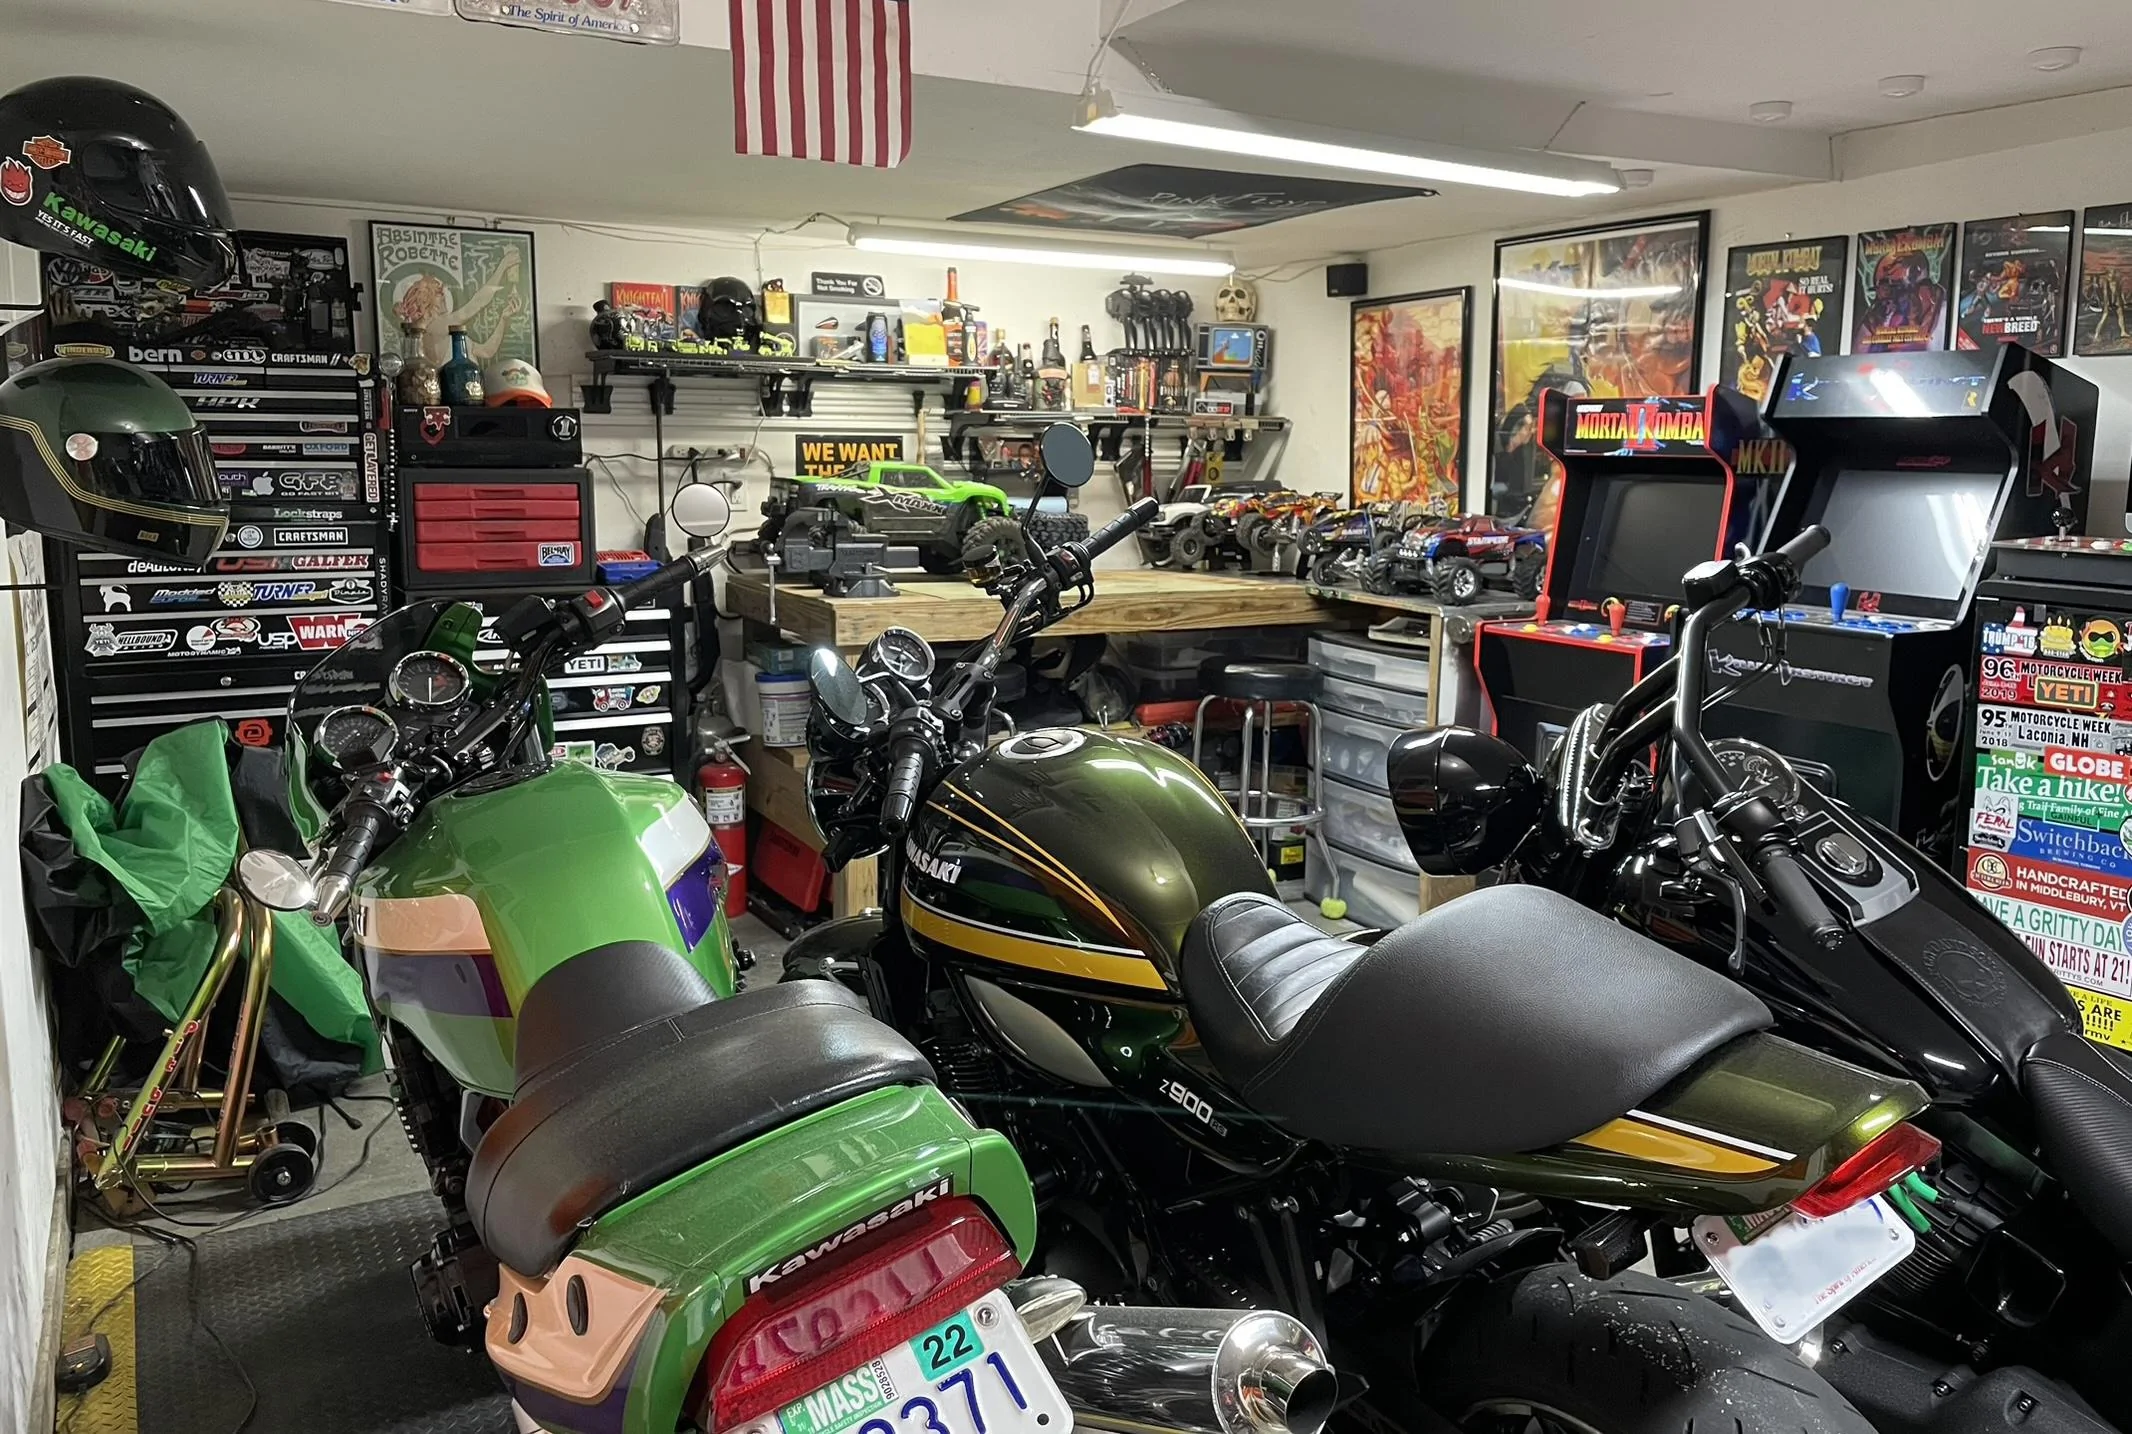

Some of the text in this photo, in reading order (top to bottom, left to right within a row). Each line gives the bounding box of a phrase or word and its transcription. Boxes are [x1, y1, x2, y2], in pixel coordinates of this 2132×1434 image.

[508, 4, 632, 33] The Spirit of America
[36, 209, 52, 225] YES
[70, 229, 94, 246] FAST
[43, 191, 157, 262] Kawasaki
[376, 227, 458, 249] ABSINTHE
[378, 245, 459, 278] ROBETTE
[829, 286, 855, 294] Smoking
[2004, 320, 2038, 334] BREED
[128, 346, 183, 363] bern
[271, 353, 328, 364] CRAFTSMAN
[1636, 411, 1706, 440] KOMBA
[304, 443, 349, 451] OXFORD
[365, 434, 376, 453] GET
[802, 442, 899, 462] WE WANT
[218, 473, 247, 482] outh
[366, 453, 379, 502] LAYERED!
[273, 508, 343, 521] Lockstraps
[279, 532, 344, 542] CRAFTSMAN
[292, 556, 369, 569] GALFER
[253, 582, 316, 601] TURNER
[379, 557, 389, 615] SHADYRAY
[117, 635, 164, 645] HELLBOUND
[298, 624, 348, 640] WARN
[1982, 627, 2036, 650] TRUMP '16
[568, 659, 602, 671] YETI
[2021, 661, 2093, 681] MOTORCYCLE
[2093, 670, 2123, 684] WEEK
[1982, 687, 2017, 700] 2019
[2040, 682, 2092, 703] YETI
[2010, 711, 2080, 730] MOTORCYCLE
[2082, 720, 2112, 734] WEEK
[1981, 736, 2009, 747] 2018
[2018, 725, 2090, 748] Laconia, NH
[2050, 752, 2124, 779] GLOBE
[1977, 765, 2122, 803] Take a hike!
[2027, 799, 2047, 811] Trail
[2051, 803, 2080, 815] Family
[2084, 806, 2098, 816] of
[2098, 807, 2119, 819] Fine
[2050, 811, 2093, 826] GAINFUL
[1975, 811, 2014, 829] FERAL
[906, 832, 962, 884] WASAKI
[2039, 848, 2117, 868] BREWING CO
[2016, 866, 2127, 900] HANDCRAFTED
[2016, 880, 2127, 912] IN MIDDLEBURY, VT
[2013, 905, 2025, 929] A
[2029, 908, 2090, 943] GRITTY
[2049, 940, 2091, 974] STARTS
[2094, 952, 2108, 979] AT
[2111, 957, 2131, 985] 21!
[2052, 969, 2104, 987] RITTYS.COM
[2090, 995, 2113, 1007] LIFE
[2091, 1004, 2122, 1022] ARE
[749, 1178, 950, 1295] Kawasaki
[923, 1324, 973, 1370] 22
[871, 1360, 895, 1401] 9028528
[804, 1366, 880, 1431] MASS
[786, 1402, 806, 1419] EXP.
